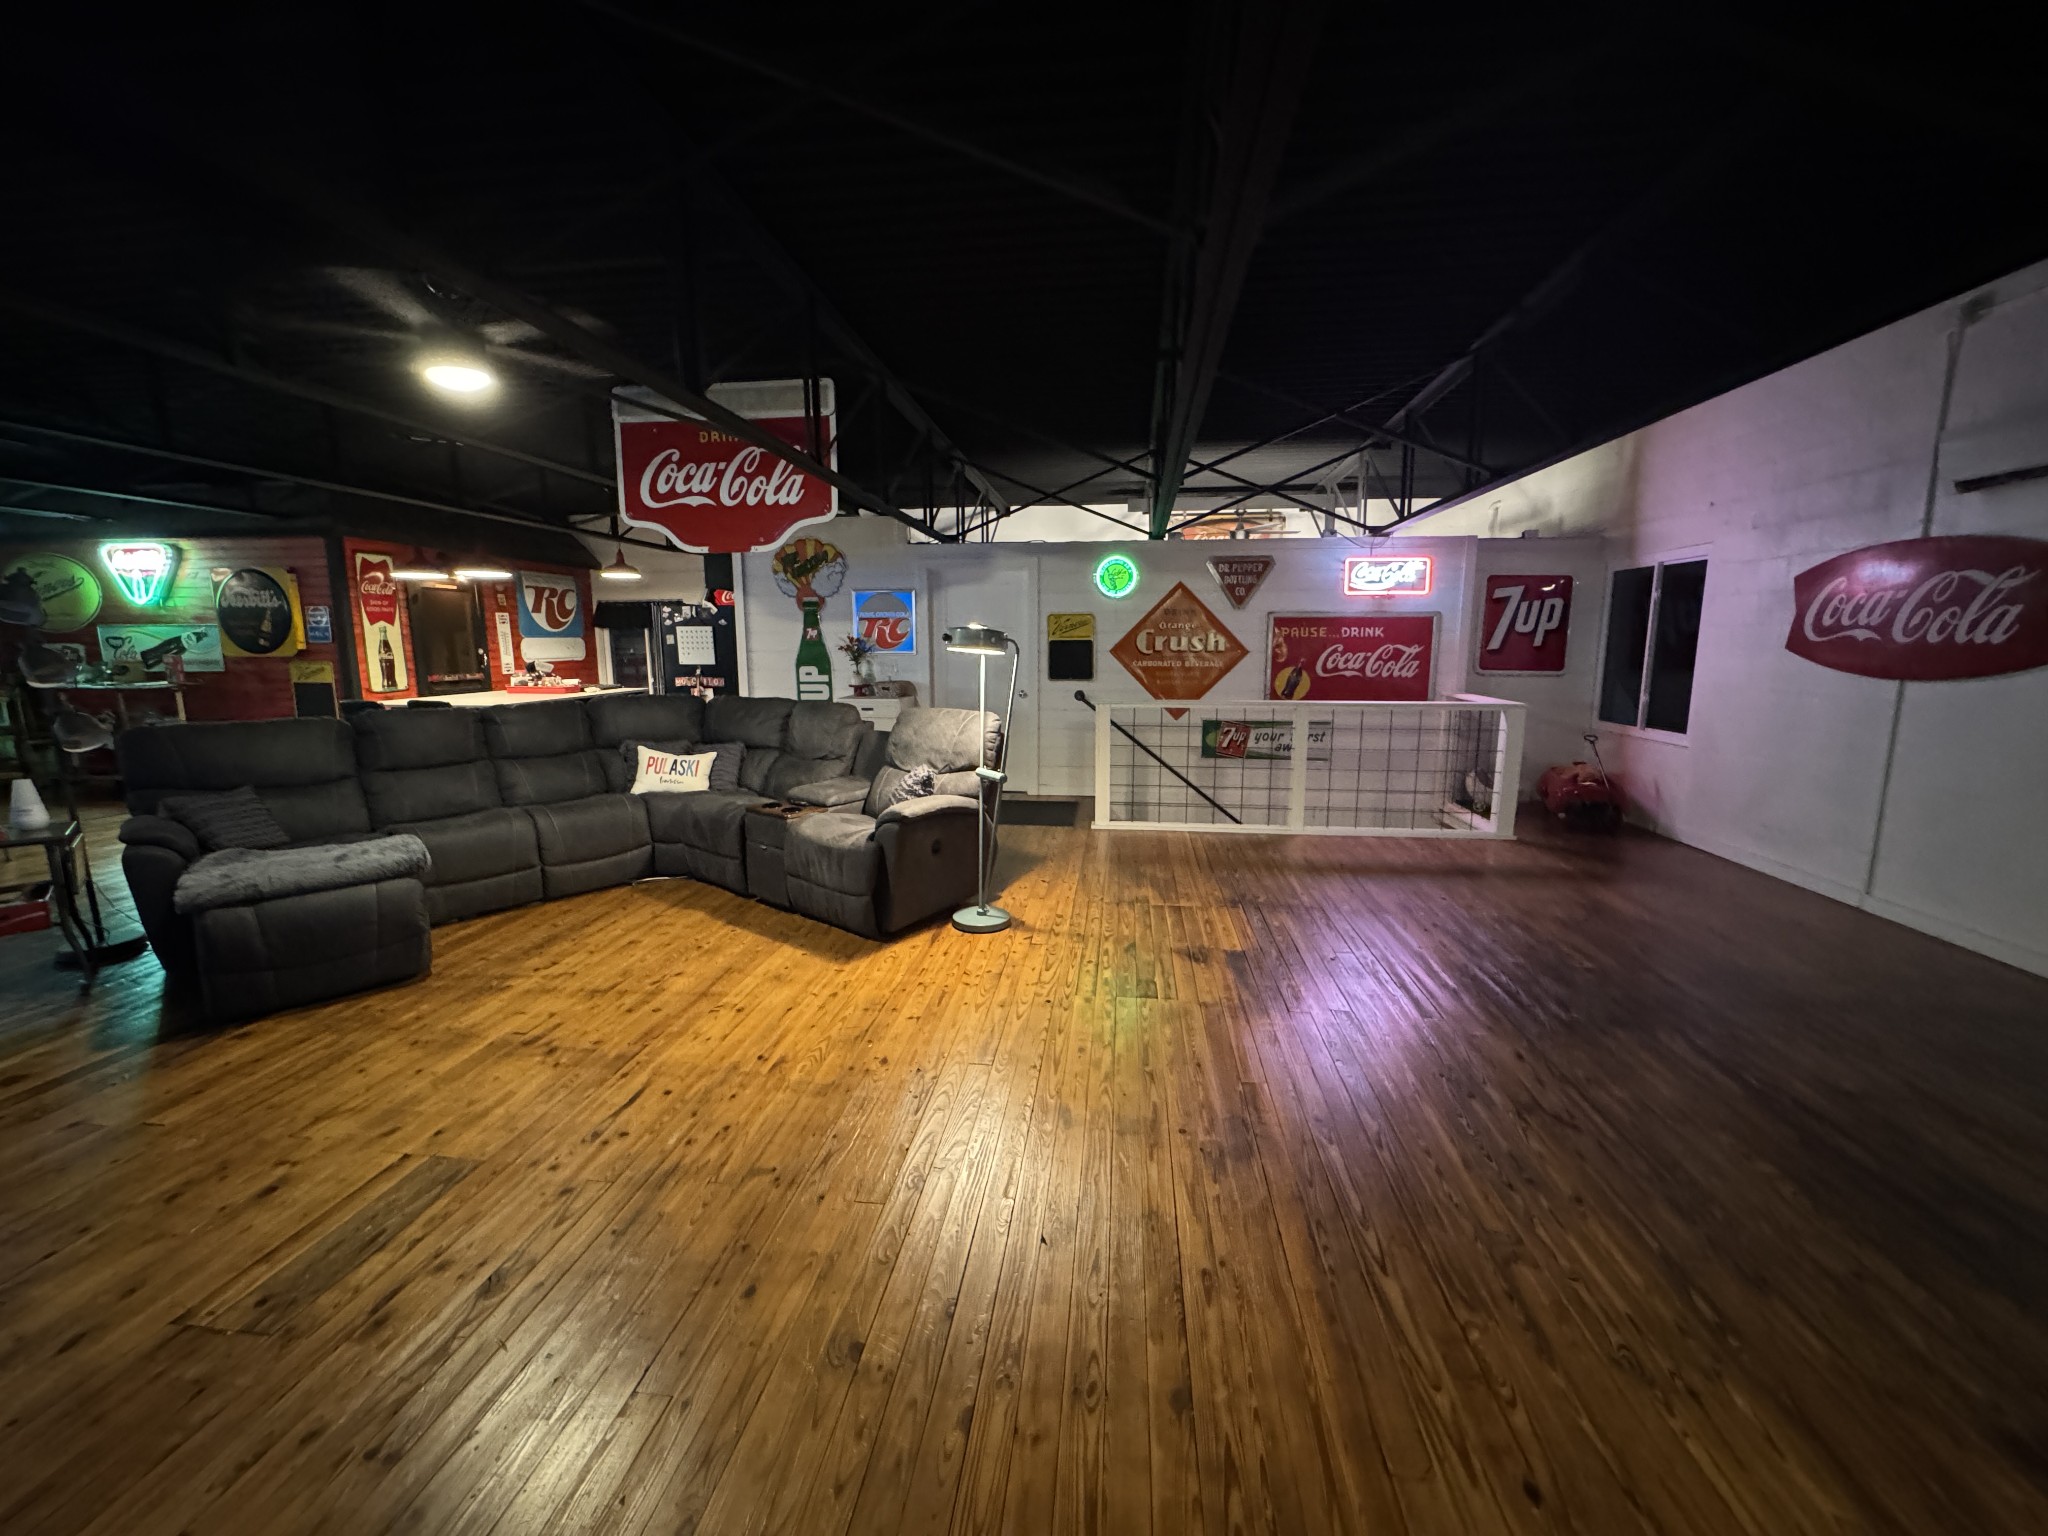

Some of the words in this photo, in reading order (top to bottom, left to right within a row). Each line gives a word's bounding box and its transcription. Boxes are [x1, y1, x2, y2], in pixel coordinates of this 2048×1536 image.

[699, 430, 739, 443] DRI
[640, 445, 807, 508] Coca-Cola
[1232, 563, 1263, 572] PEPPER
[361, 580, 396, 595] Coca-Cola
[525, 585, 576, 630] RC
[1486, 585, 1562, 650] 7up
[1803, 565, 2042, 645] Coca-Cola
[858, 617, 911, 649] RC
[1159, 621, 1197, 630] Orange
[1341, 626, 1385, 638] DRINK
[1136, 628, 1227, 655] Crush
[1315, 644, 1425, 679] Coca-Cola
[1254, 732, 1284, 744] your
[645, 755, 700, 778] PULASKI
